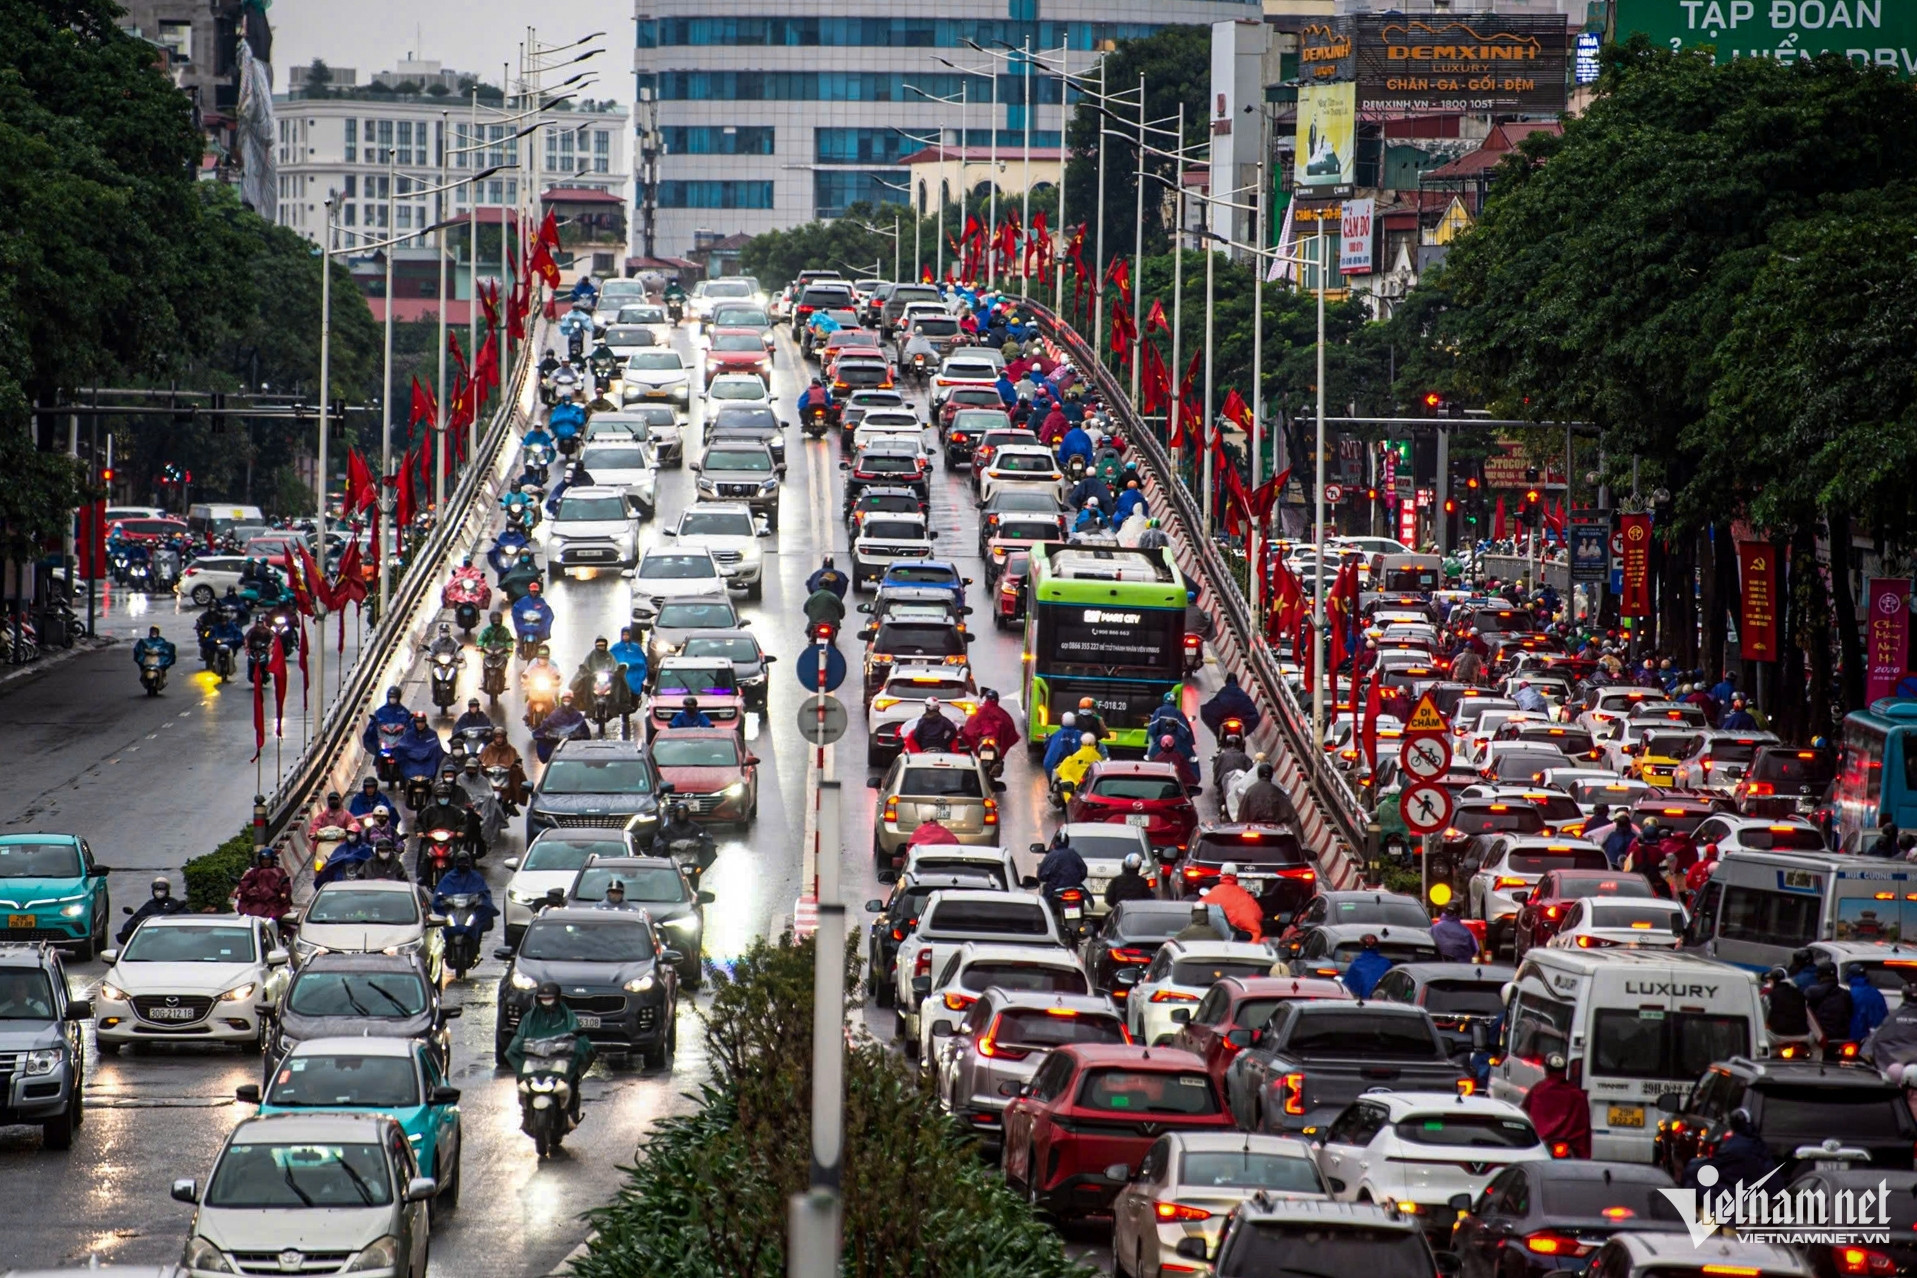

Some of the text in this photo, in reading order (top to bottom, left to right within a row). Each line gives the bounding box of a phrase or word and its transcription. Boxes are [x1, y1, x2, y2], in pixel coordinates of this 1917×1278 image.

[1303, 44, 1350, 62] DEMXINH
[1387, 46, 1535, 60] DEMXINH
[1432, 64, 1490, 73] LUXURY
[1504, 76, 1534, 92] ĐỆM
[1362, 99, 1493, 109] DEMXINH.VN 1800 1051
[1874, 666, 1901, 674] 2026
[1097, 700, 1127, 710] F-018.20
[1411, 717, 1440, 730] CHẬM
[1625, 981, 1718, 998] LUXURY
